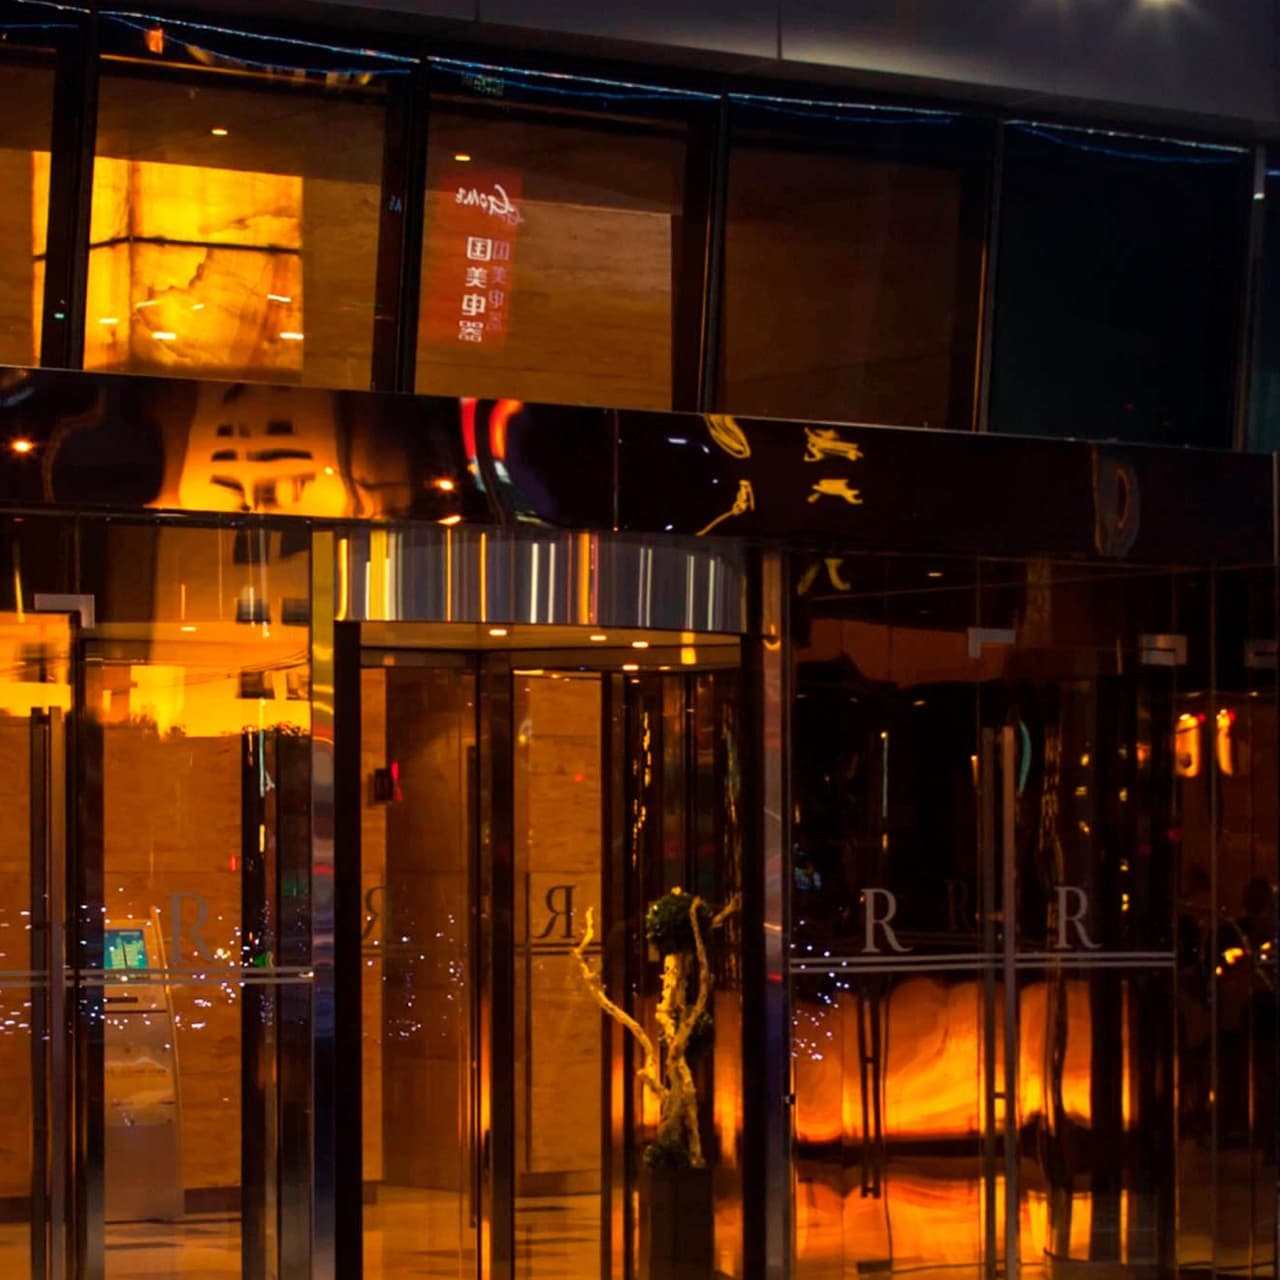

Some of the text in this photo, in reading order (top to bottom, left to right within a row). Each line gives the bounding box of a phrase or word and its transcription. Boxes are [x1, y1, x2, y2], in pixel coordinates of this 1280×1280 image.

[165, 890, 225, 966] R
[860, 887, 914, 953] R
[1053, 885, 1104, 950] R
